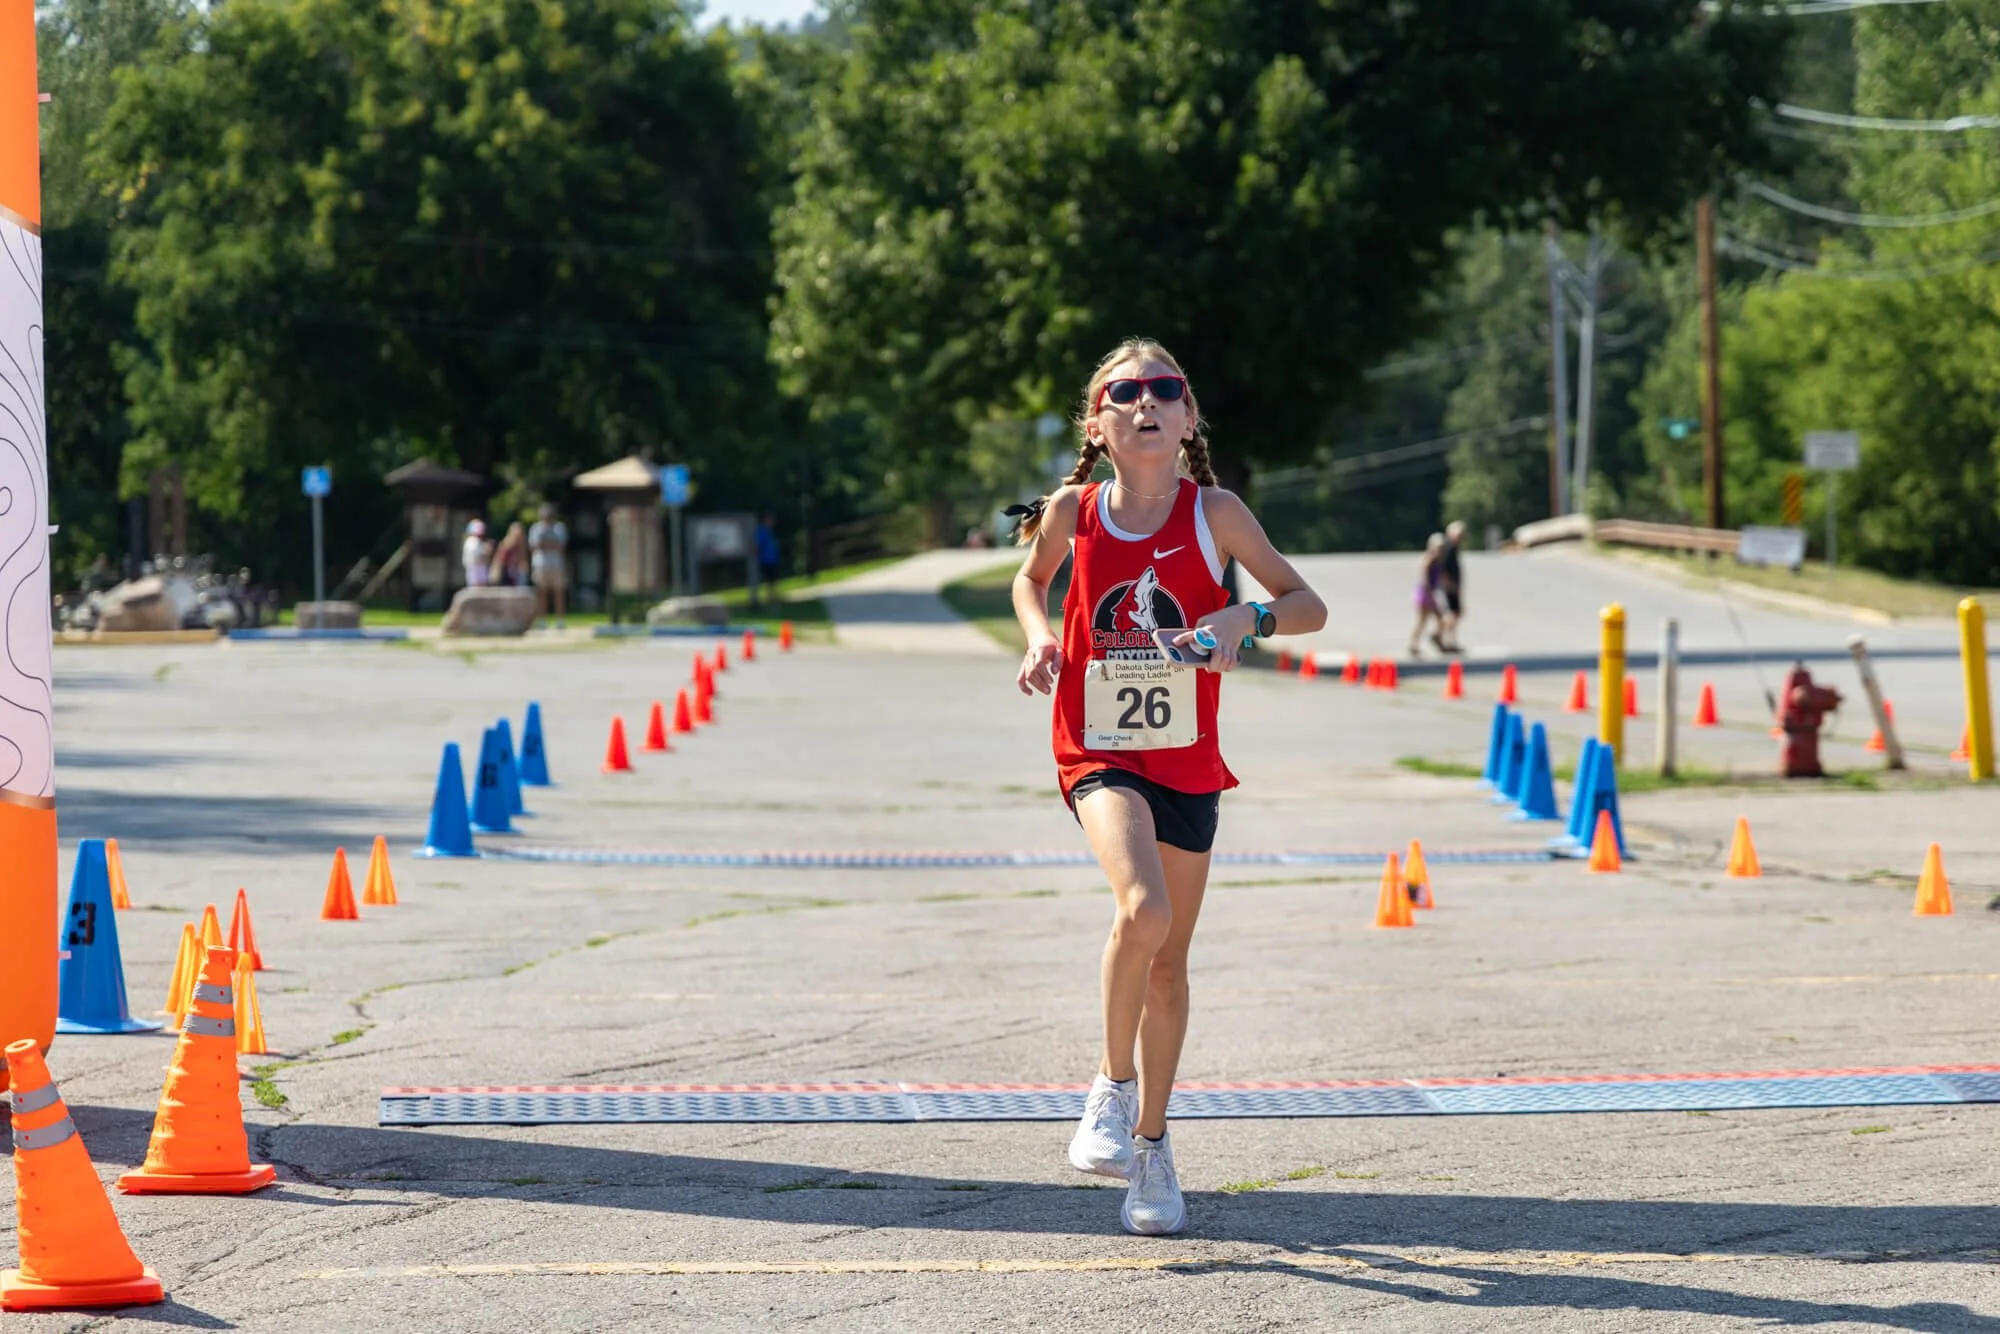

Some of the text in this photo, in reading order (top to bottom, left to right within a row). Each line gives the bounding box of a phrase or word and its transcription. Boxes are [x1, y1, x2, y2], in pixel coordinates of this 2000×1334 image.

[1115, 663, 1142, 671] Dakota
[1144, 663, 1164, 672] Spirit
[1115, 671, 1172, 680] Leading Ladies
[1116, 686, 1171, 729] 26
[69, 901, 96, 946] 3
